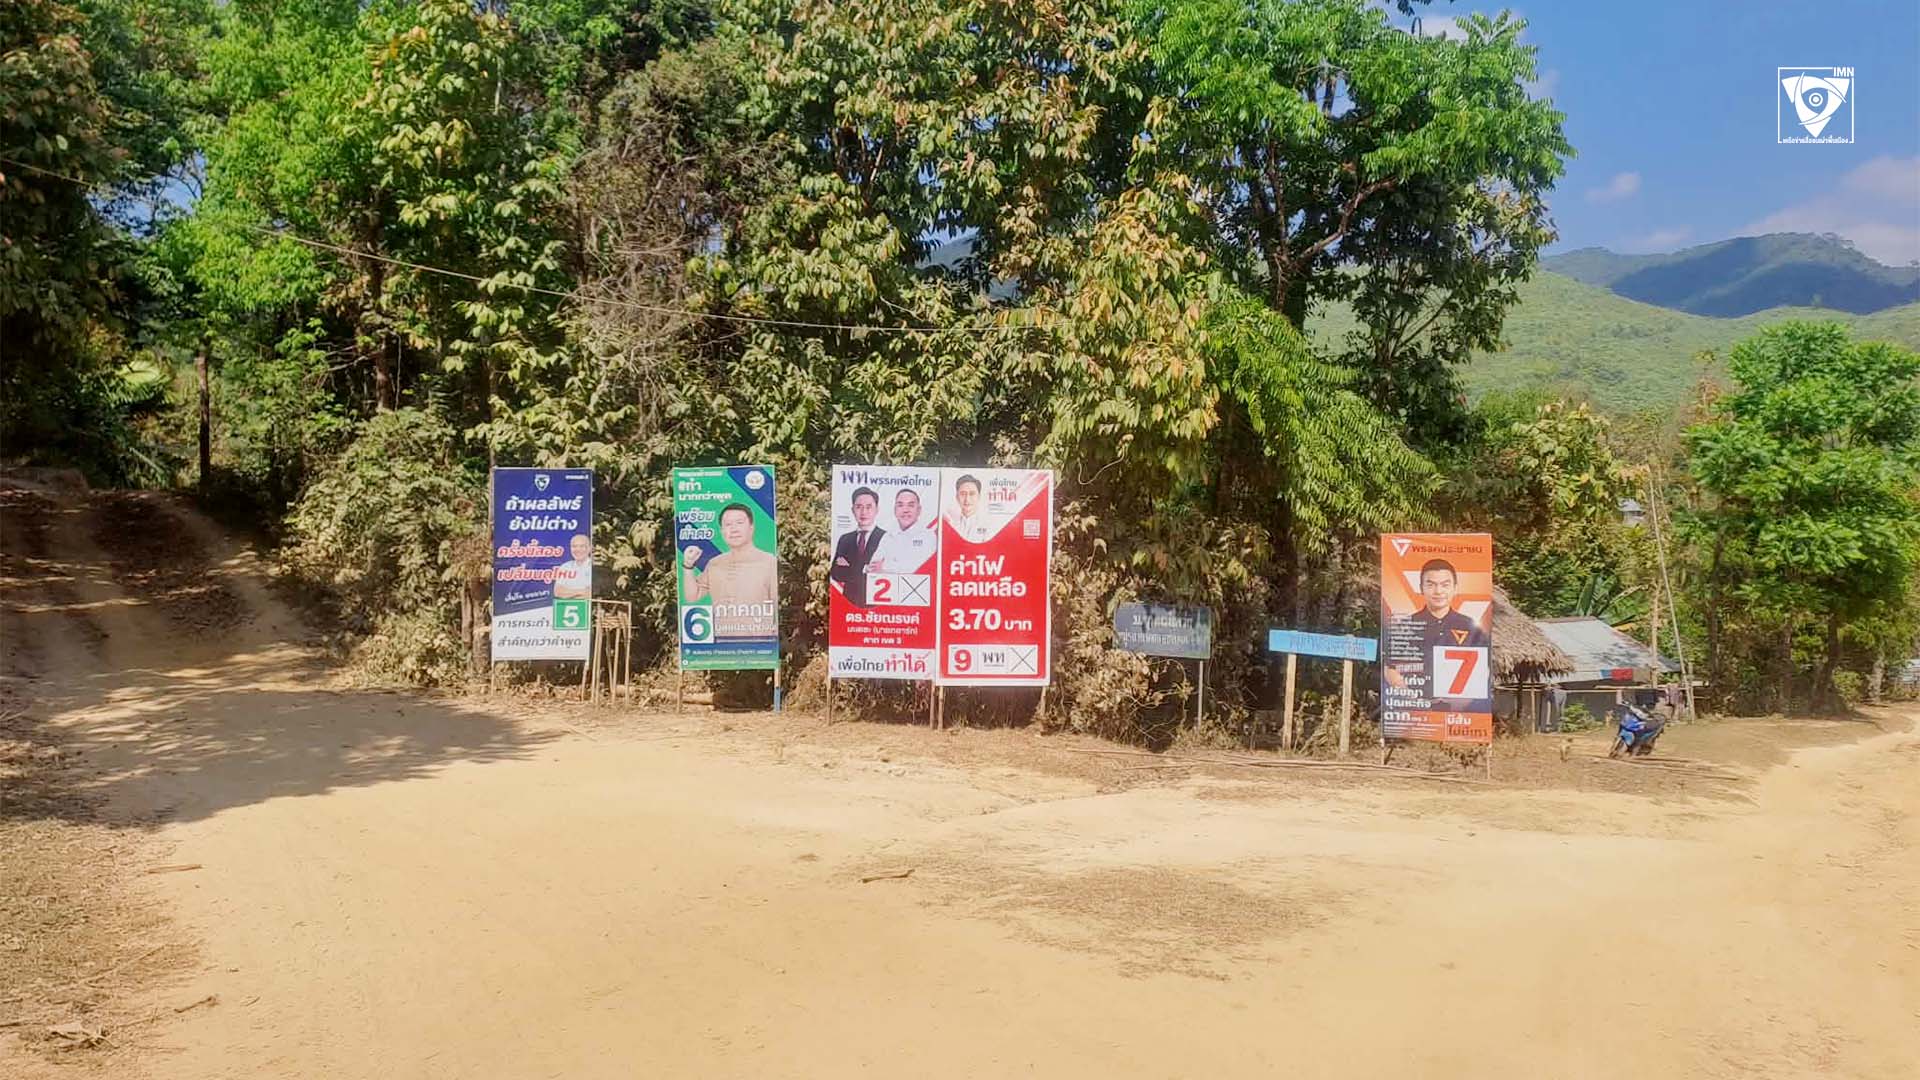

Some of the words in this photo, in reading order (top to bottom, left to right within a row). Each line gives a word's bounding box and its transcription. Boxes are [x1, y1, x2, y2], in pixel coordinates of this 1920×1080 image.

[509, 515, 579, 531] ยังไม่ต่าง
[950, 555, 1005, 576] ค่าไฟ
[873, 579, 892, 602] 2
[949, 576, 1027, 597] ลดเหลือ
[498, 617, 550, 628] การกระทำ
[563, 606, 579, 627] 5
[684, 607, 711, 641] 6
[949, 608, 1001, 631] 3.70
[1004, 619, 1033, 631] บาท
[954, 649, 972, 672] 9
[1445, 650, 1479, 695] 7
